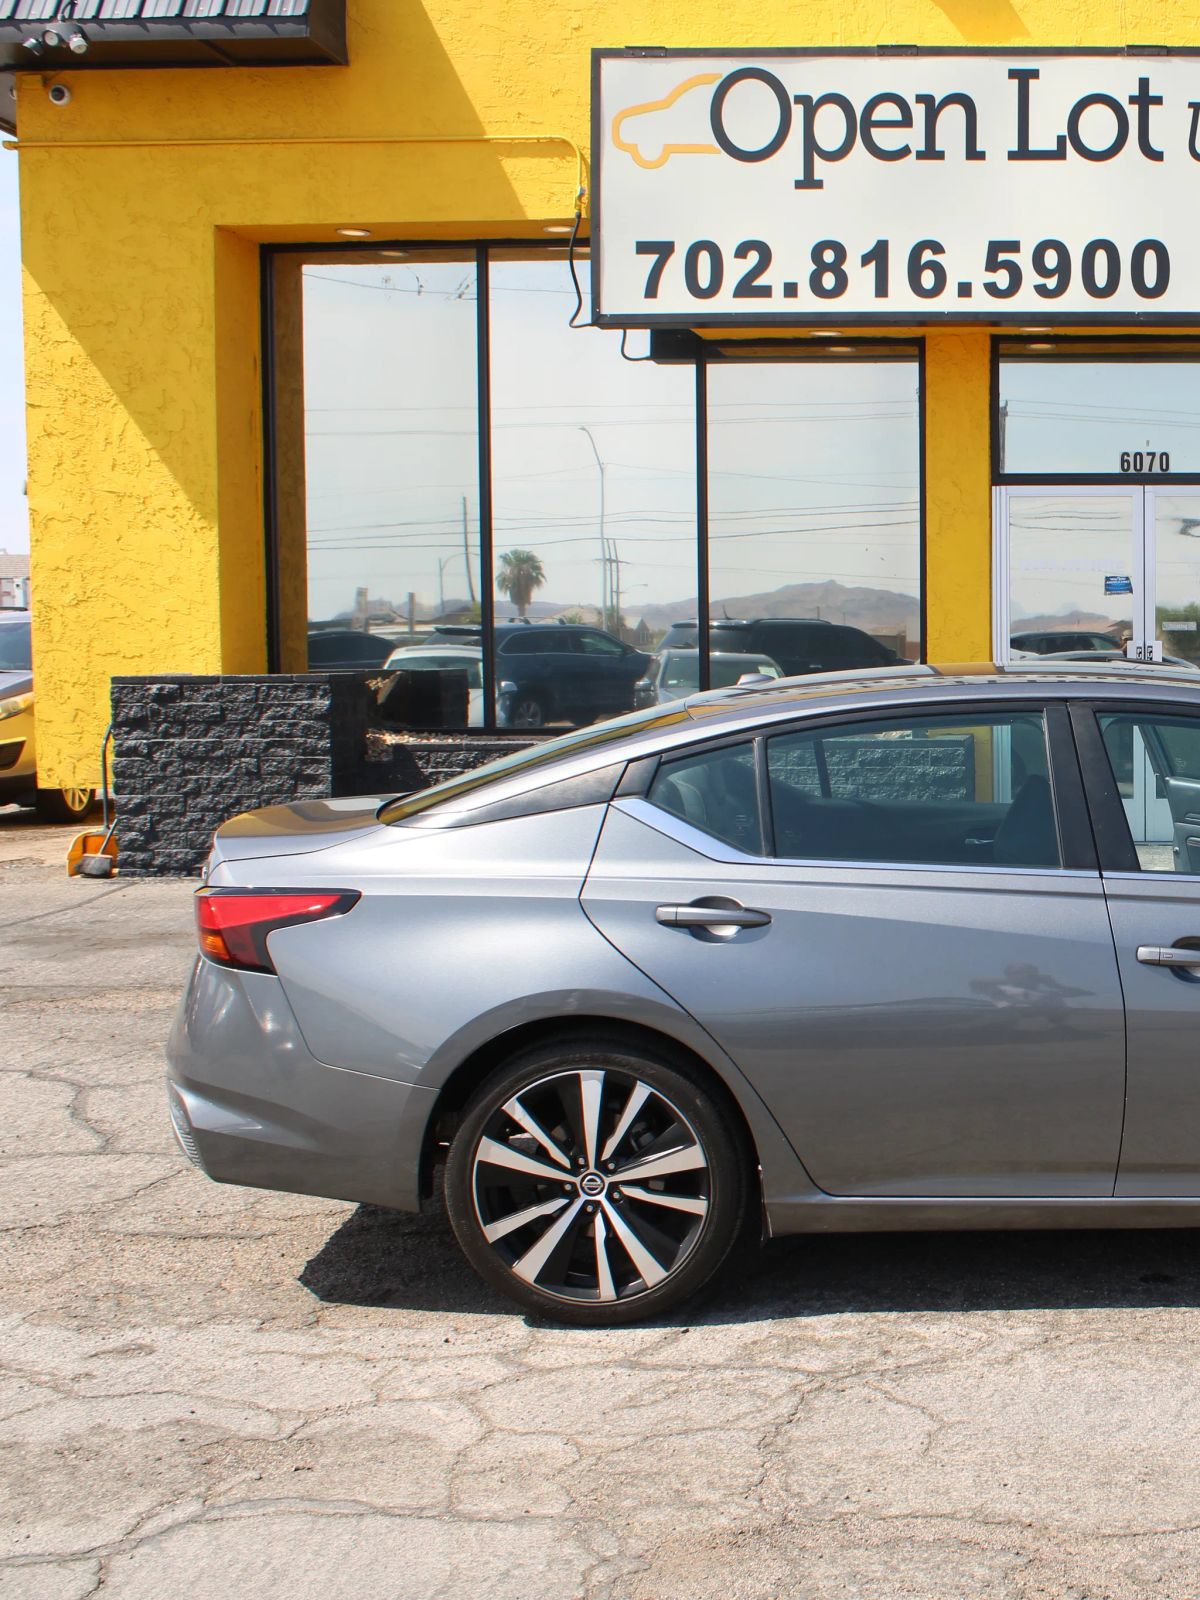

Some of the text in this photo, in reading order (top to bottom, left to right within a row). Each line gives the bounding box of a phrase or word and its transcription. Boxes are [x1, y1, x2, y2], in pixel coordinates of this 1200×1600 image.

[711, 67, 986, 190] Open
[1007, 68, 1164, 162] Lot
[635, 238, 1171, 300] 702.816.5900
[1120, 451, 1170, 473] 6070
